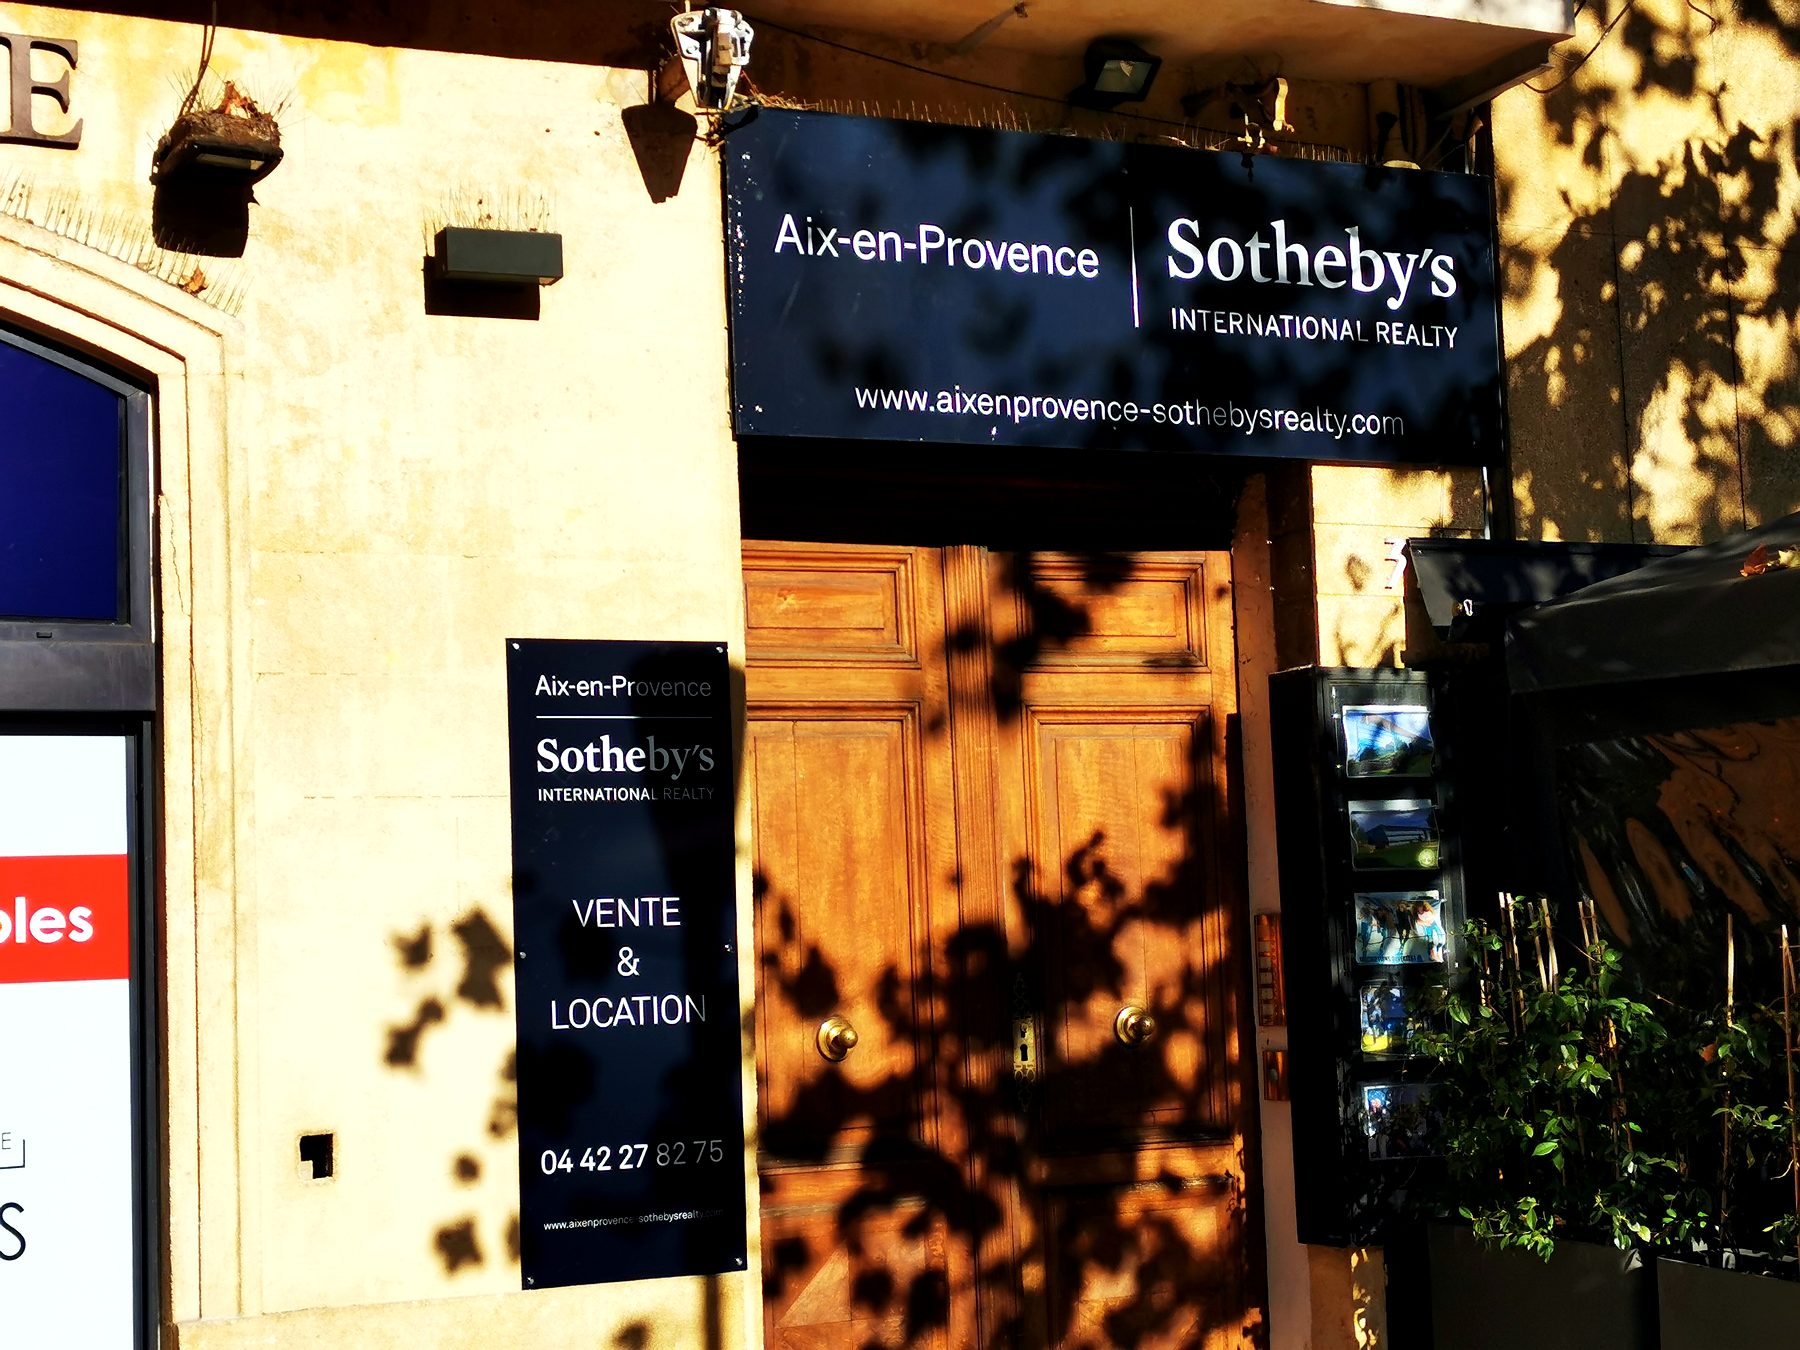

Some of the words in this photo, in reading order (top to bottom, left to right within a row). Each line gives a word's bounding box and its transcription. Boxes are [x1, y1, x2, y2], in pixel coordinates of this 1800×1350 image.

[775, 213, 1100, 281] Aix-en-Provence
[1166, 217, 1457, 311] Sotheby's
[1171, 306, 1369, 342] INTERNATIONAL
[1376, 321, 1458, 349] REALTY
[855, 384, 1405, 438] www.aixenprovence-sothebysrealty.com
[1383, 537, 1407, 590] 3
[535, 674, 712, 698] Aix-en-Provence
[536, 734, 715, 780] Sotheby's
[537, 785, 659, 803] INTERNATIONAL
[663, 787, 714, 801] REALTY
[572, 896, 681, 928] VENTE
[616, 946, 640, 977] &
[550, 993, 706, 1030] LOCATION
[540, 1148, 574, 1175] 04
[579, 1145, 612, 1172] 42
[618, 1143, 649, 1170] 27
[656, 1141, 686, 1167] 82
[693, 1139, 723, 1164] 75
